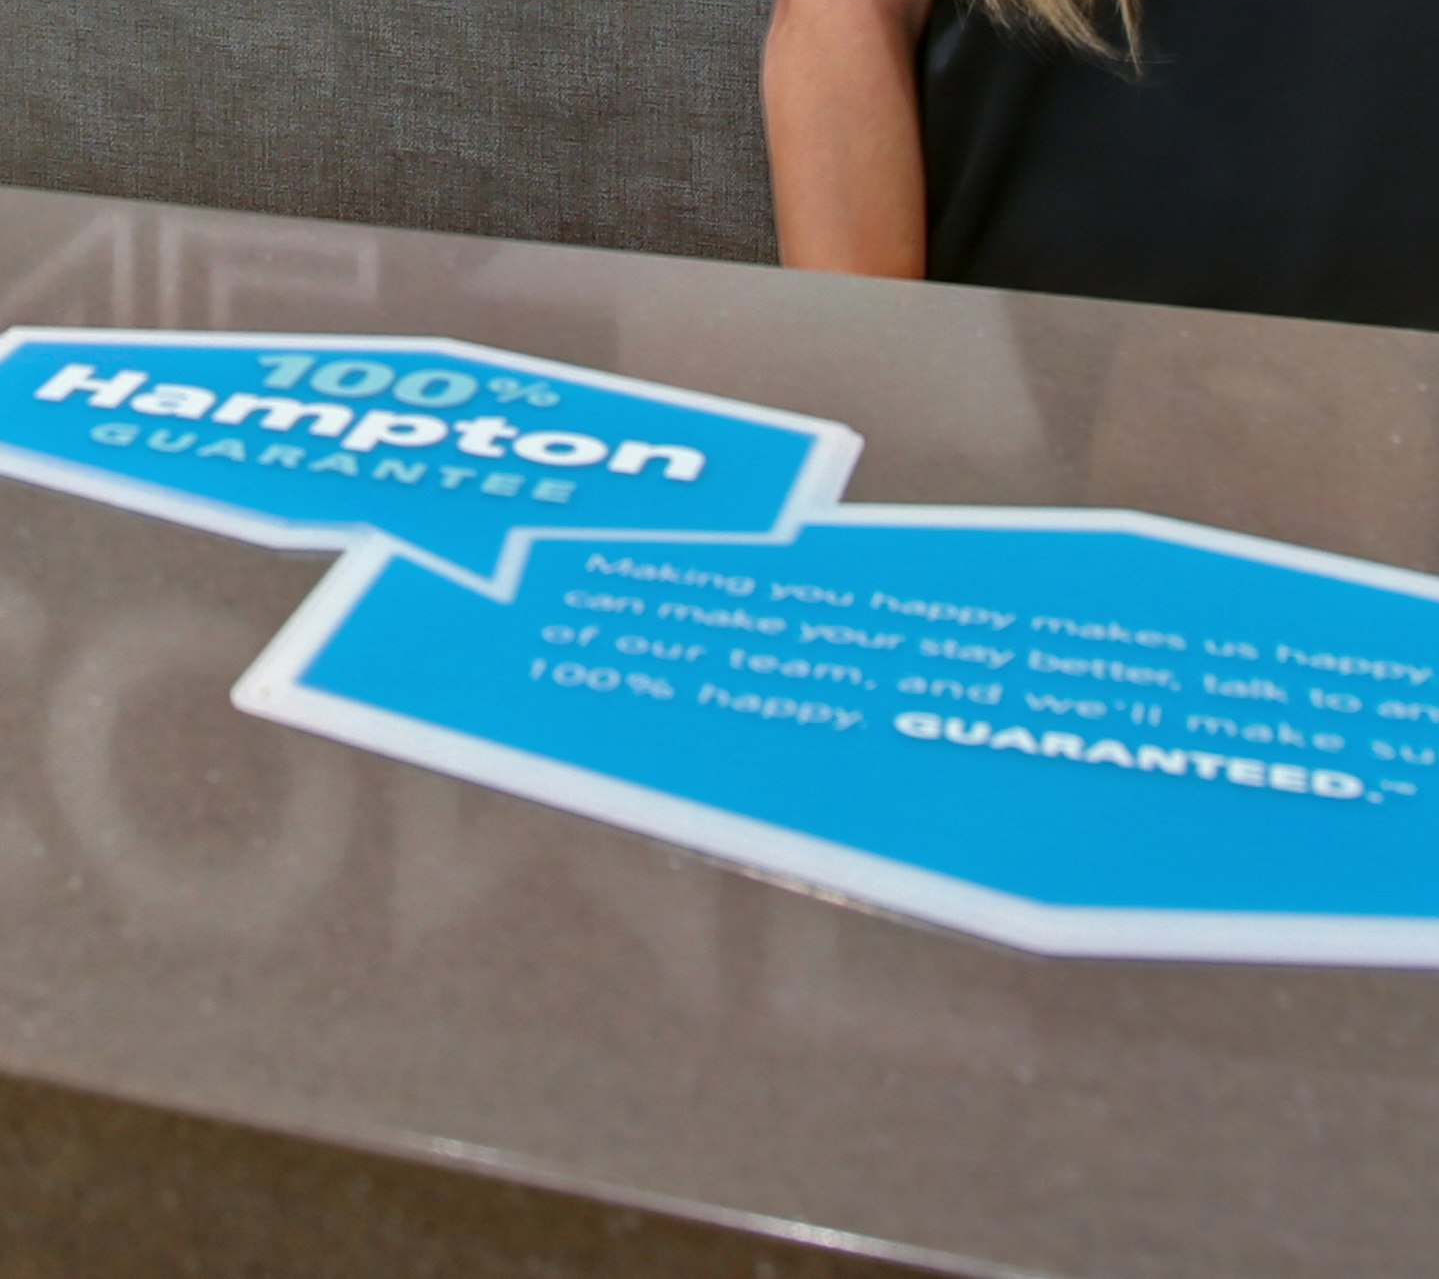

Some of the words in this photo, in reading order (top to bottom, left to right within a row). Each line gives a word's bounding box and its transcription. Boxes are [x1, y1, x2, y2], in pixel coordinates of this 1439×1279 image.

[32, 362, 708, 483] Hampton
[258, 353, 562, 410] 100%
[88, 421, 580, 504] GUARANTEE
[563, 589, 646, 616] can
[656, 600, 788, 636] make
[798, 620, 907, 651] your
[919, 637, 1017, 670] stay
[1203, 672, 1289, 705] talk
[1309, 687, 1363, 713] to
[584, 553, 757, 598] Making
[769, 582, 855, 608] you
[869, 591, 1017, 631] happy
[1030, 614, 1188, 652] makes
[1203, 639, 1260, 661] us
[529, 657, 676, 702] 100%
[540, 624, 600, 648] of
[615, 634, 709, 662] our
[895, 675, 1004, 707] and
[1186, 713, 1346, 754] make
